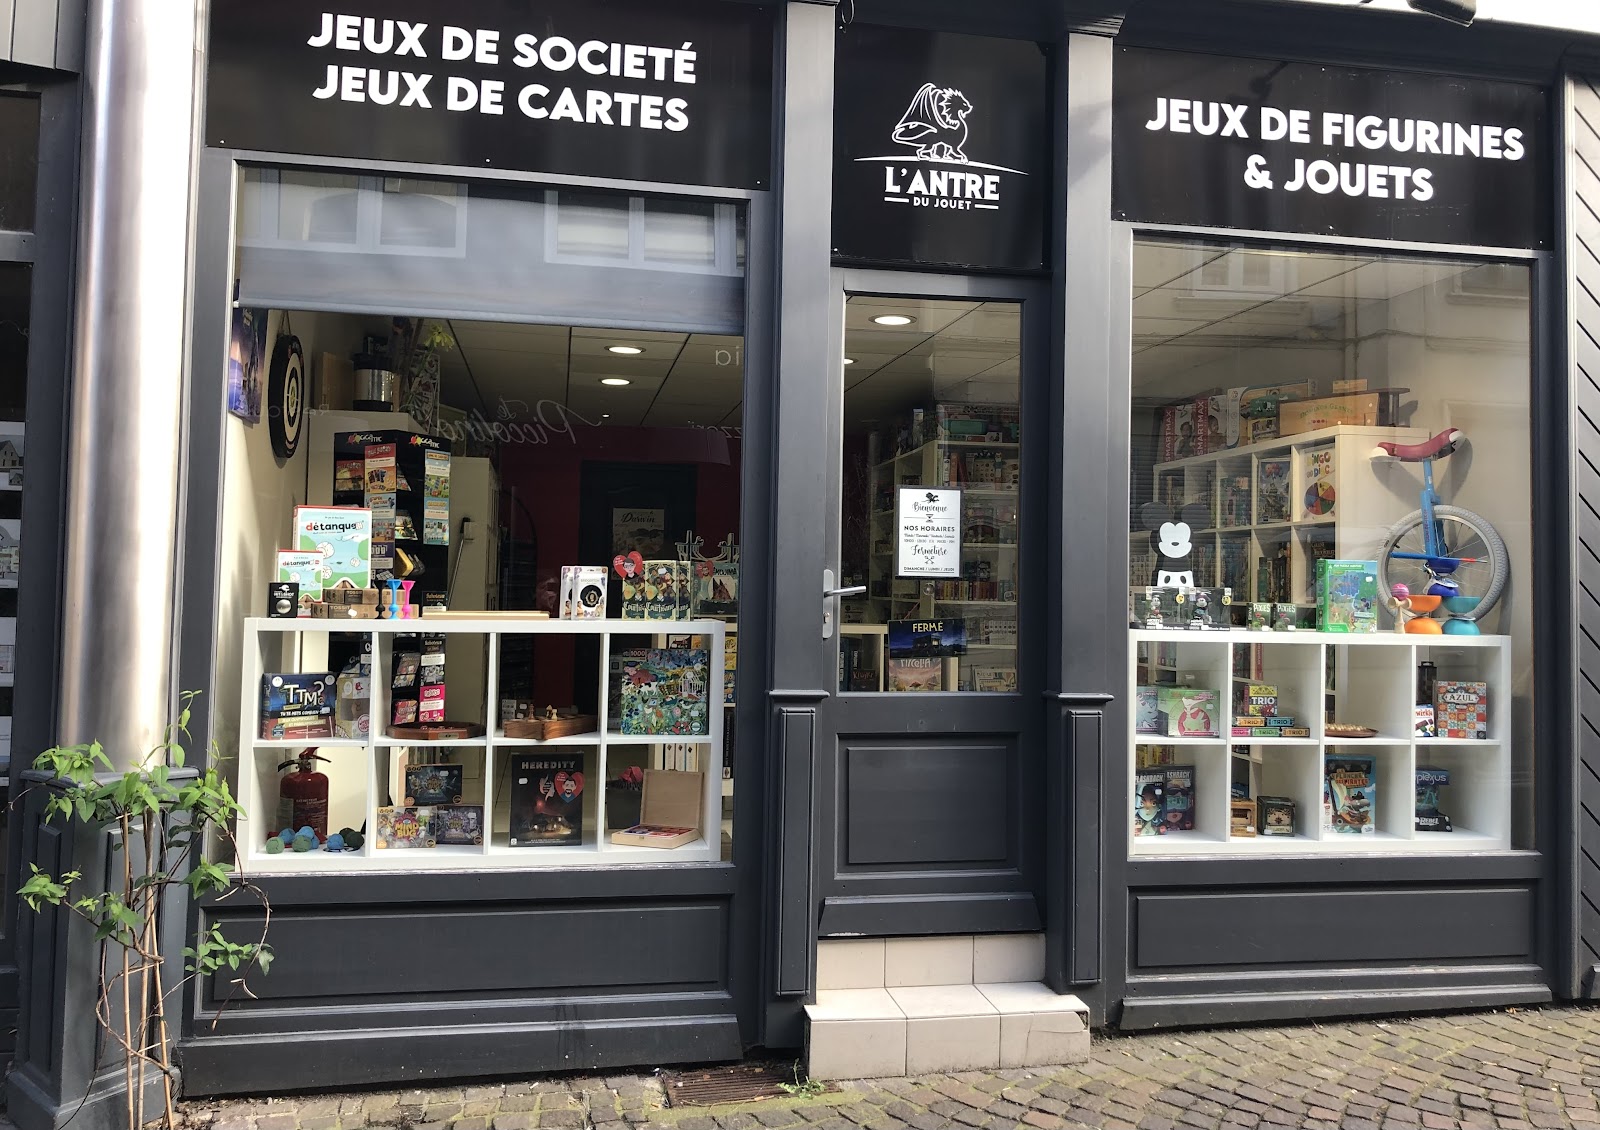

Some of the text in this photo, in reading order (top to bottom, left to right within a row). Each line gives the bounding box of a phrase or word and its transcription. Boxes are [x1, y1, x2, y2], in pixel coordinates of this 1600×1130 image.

[307, 13, 697, 84] JEUX DE SOCIETÉ
[312, 65, 688, 132] JEUX DE CARTES
[1145, 98, 1524, 161] JEUX DE FIGURINES
[885, 166, 1000, 201] L'ANTRE
[1244, 154, 1433, 201] & JOUETS
[914, 196, 972, 210] DU JOUET
[1165, 411, 1173, 462] SMARTMAX
[911, 501, 948, 513] Bienvenue
[620, 512, 655, 524] Darwin
[911, 544, 948, 556] Fermeture
[912, 621, 943, 632] FERMÉ
[1251, 696, 1275, 705] TRIO
[1449, 693, 1474, 701] AZUL
[522, 761, 576, 770] HEREDITY
[1416, 771, 1447, 785] plexus
[395, 822, 419, 831] MIND
[397, 829, 417, 838] BUG
